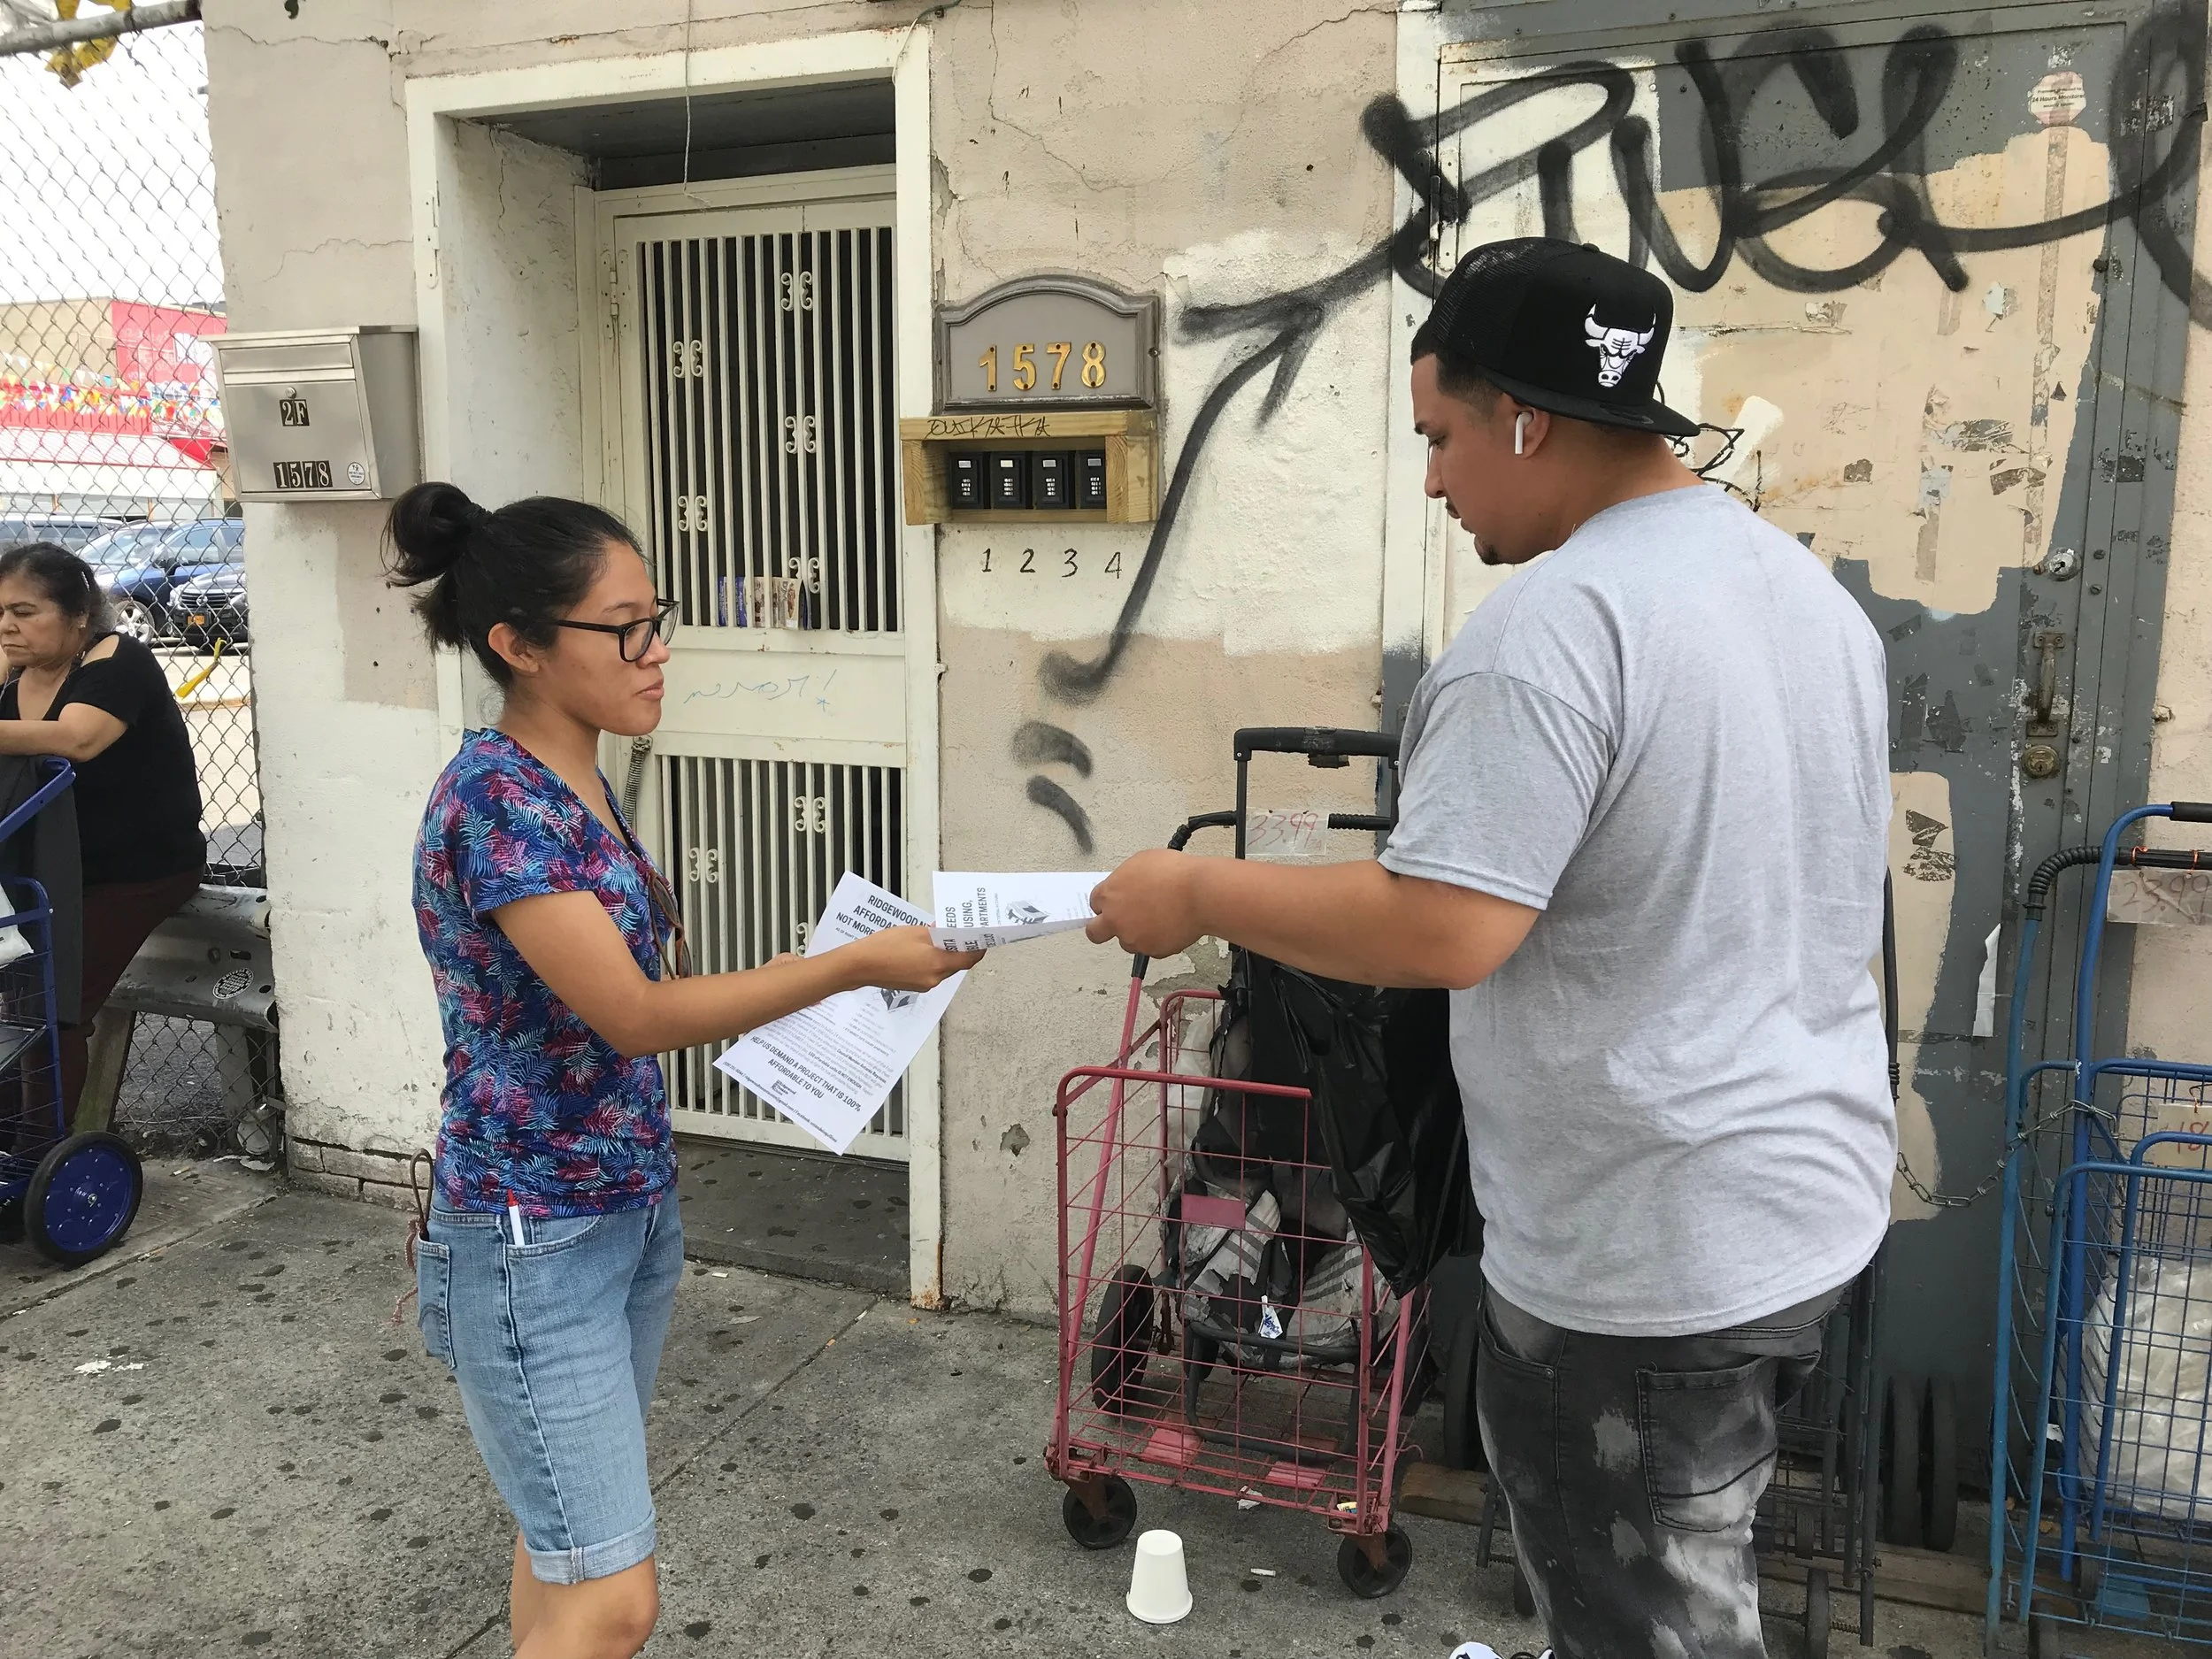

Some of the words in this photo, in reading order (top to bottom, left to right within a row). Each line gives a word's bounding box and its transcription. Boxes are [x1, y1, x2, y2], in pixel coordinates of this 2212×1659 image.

[979, 341, 1106, 391] 1578
[282, 401, 306, 425] 2F
[277, 462, 329, 487] 1578
[981, 549, 992, 573] 1
[1019, 549, 1035, 573] 2
[1062, 549, 1078, 578] 3
[1105, 551, 1122, 579] 4
[1247, 813, 1318, 849] 33.99
[835, 911, 853, 926] NOT
[867, 894, 918, 927] RIDGEWOOD
[977, 887, 989, 927] ARTMENTS
[749, 1034, 764, 1047] HELP
[761, 1041, 771, 1050] US
[767, 1046, 795, 1066] DEMAND
[795, 1064, 824, 1085] PROJECT
[820, 1079, 838, 1094] THAT
[835, 1089, 844, 1099] IS
[841, 1094, 863, 1112] 100%
[766, 1056, 805, 1086] AFFORDABLE
[802, 1080, 812, 1090] TO
[810, 1086, 825, 1099] YOU
